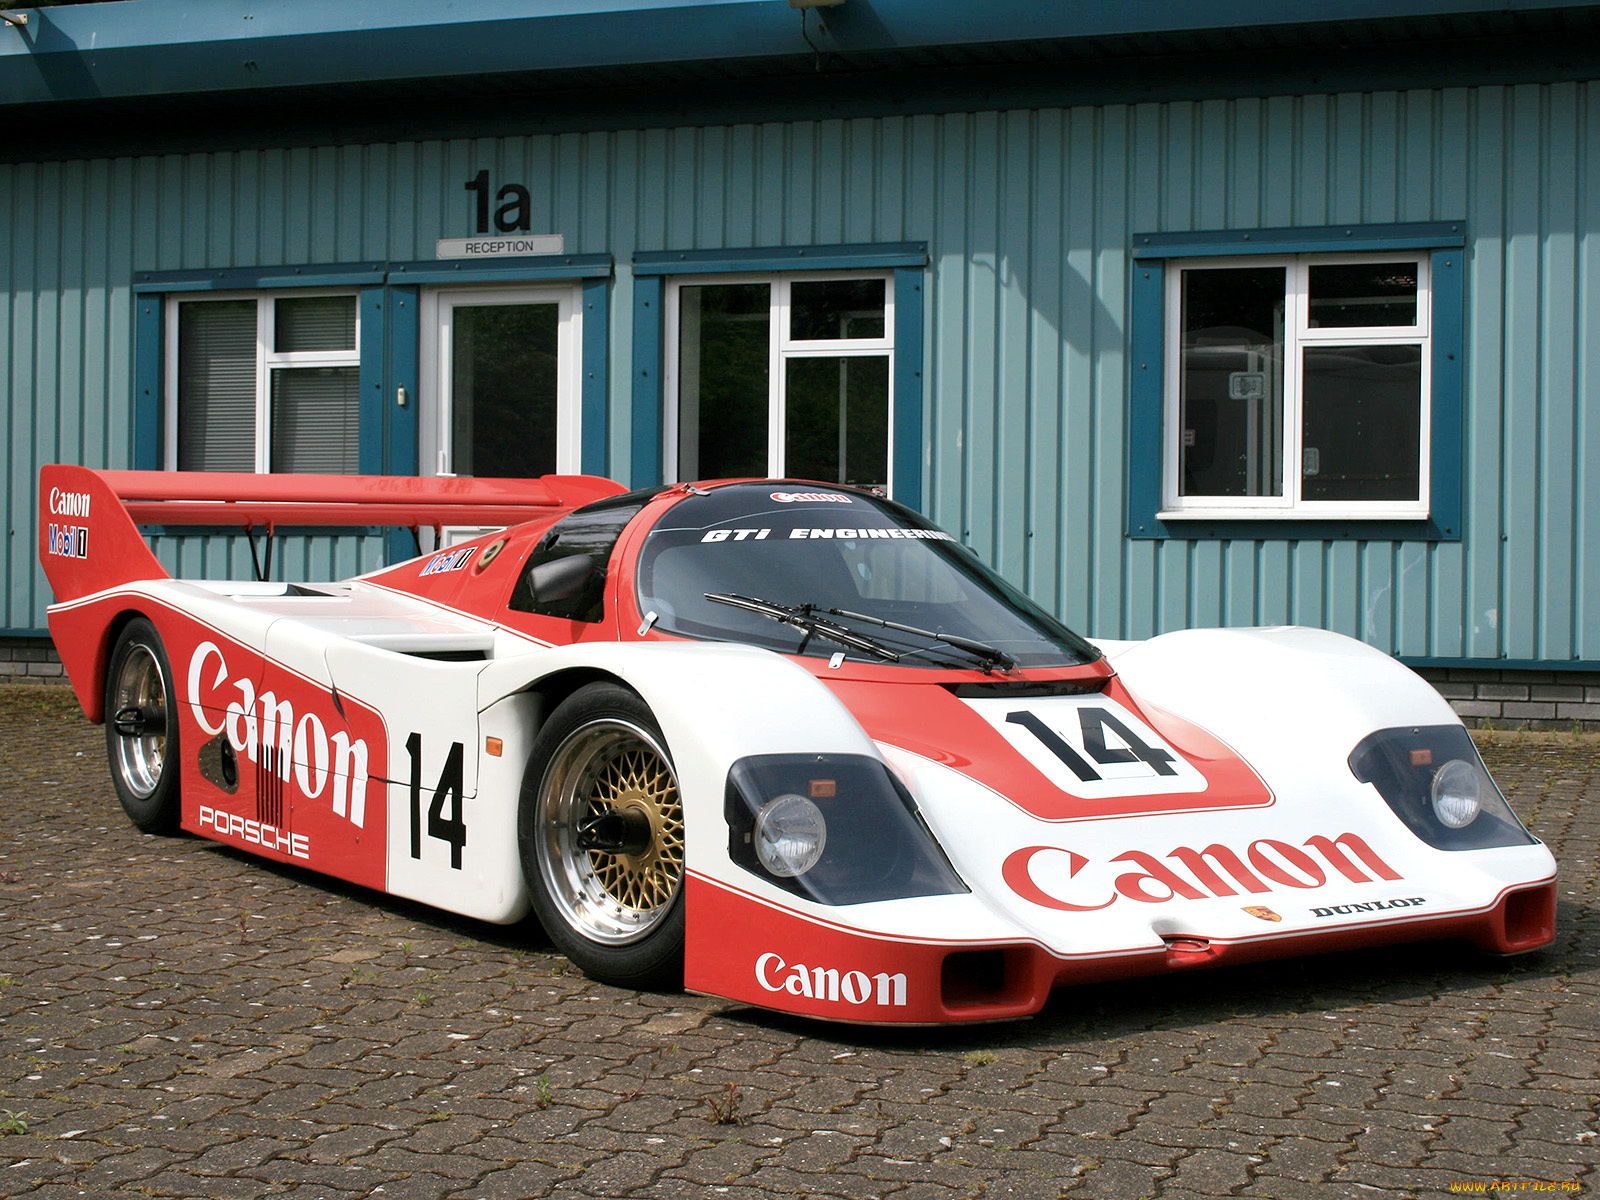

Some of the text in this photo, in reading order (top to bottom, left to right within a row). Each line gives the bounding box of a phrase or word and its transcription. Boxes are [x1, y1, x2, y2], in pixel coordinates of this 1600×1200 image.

[464, 169, 531, 233] 1a
[465, 240, 533, 253] RECEPTION
[49, 486, 91, 517] Canon
[770, 492, 852, 503] Canon
[49, 523, 87, 557] Mobil 1
[418, 548, 476, 577] Mobil 1
[187, 641, 369, 829] Canon
[1005, 707, 1178, 782] 14
[405, 732, 467, 870] 14
[199, 805, 310, 860] PORSCHE
[1002, 832, 1405, 912] Canon
[1309, 897, 1426, 917] DUNLOP
[755, 952, 907, 1006] Canon
